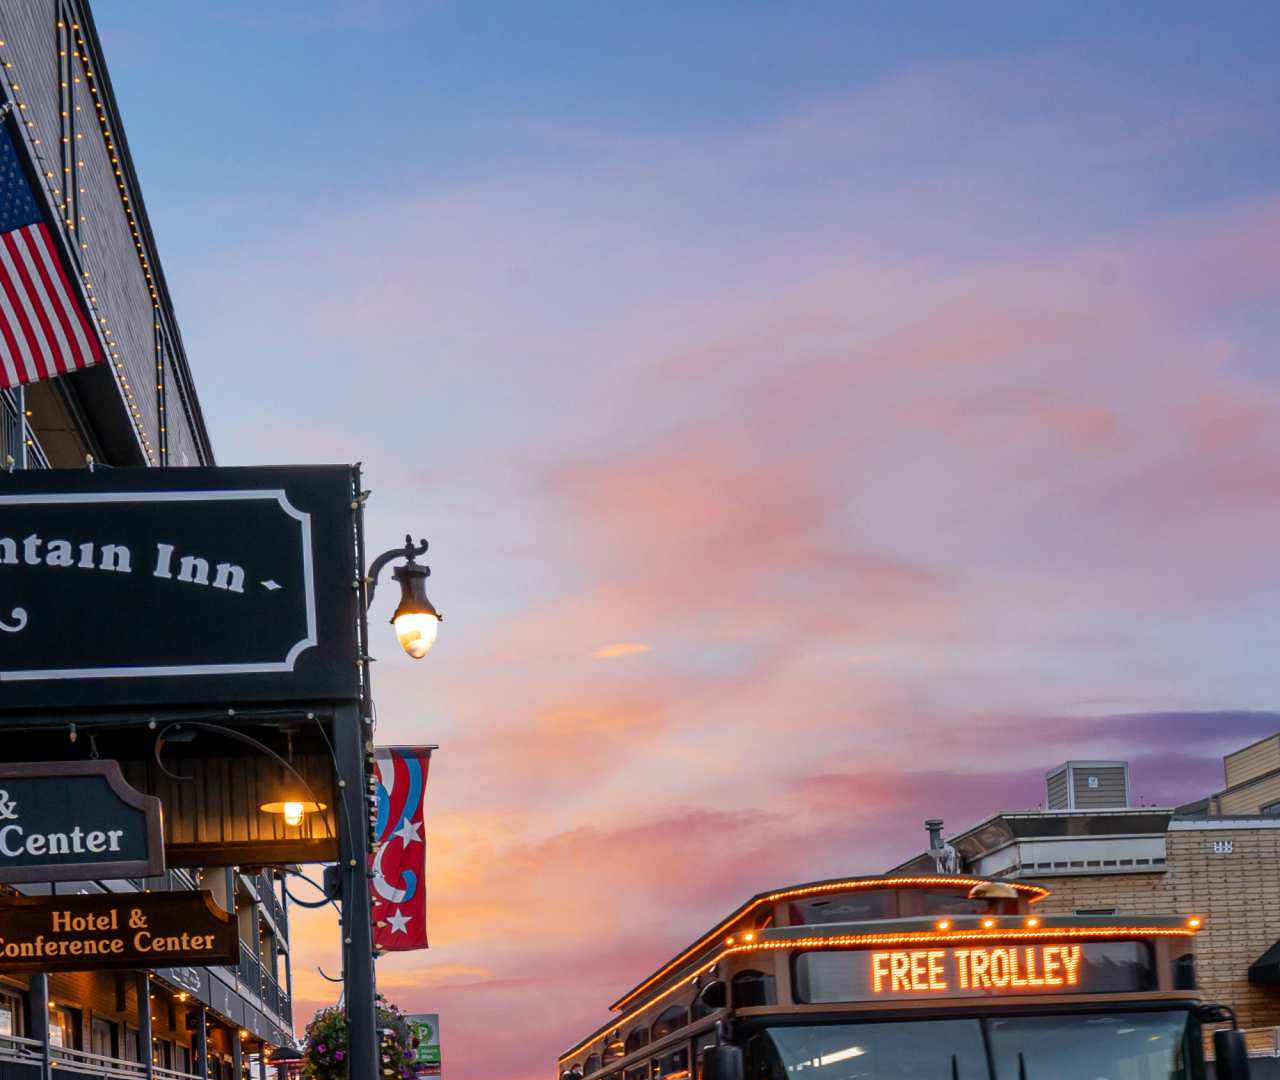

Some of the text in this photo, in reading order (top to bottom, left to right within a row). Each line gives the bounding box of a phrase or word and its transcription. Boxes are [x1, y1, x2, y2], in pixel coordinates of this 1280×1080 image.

[153, 543, 246, 593] Inn
[51, 908, 148, 933] Hotel &
[133, 930, 215, 953] Center
[872, 945, 1082, 993] FREE TROLLEY
